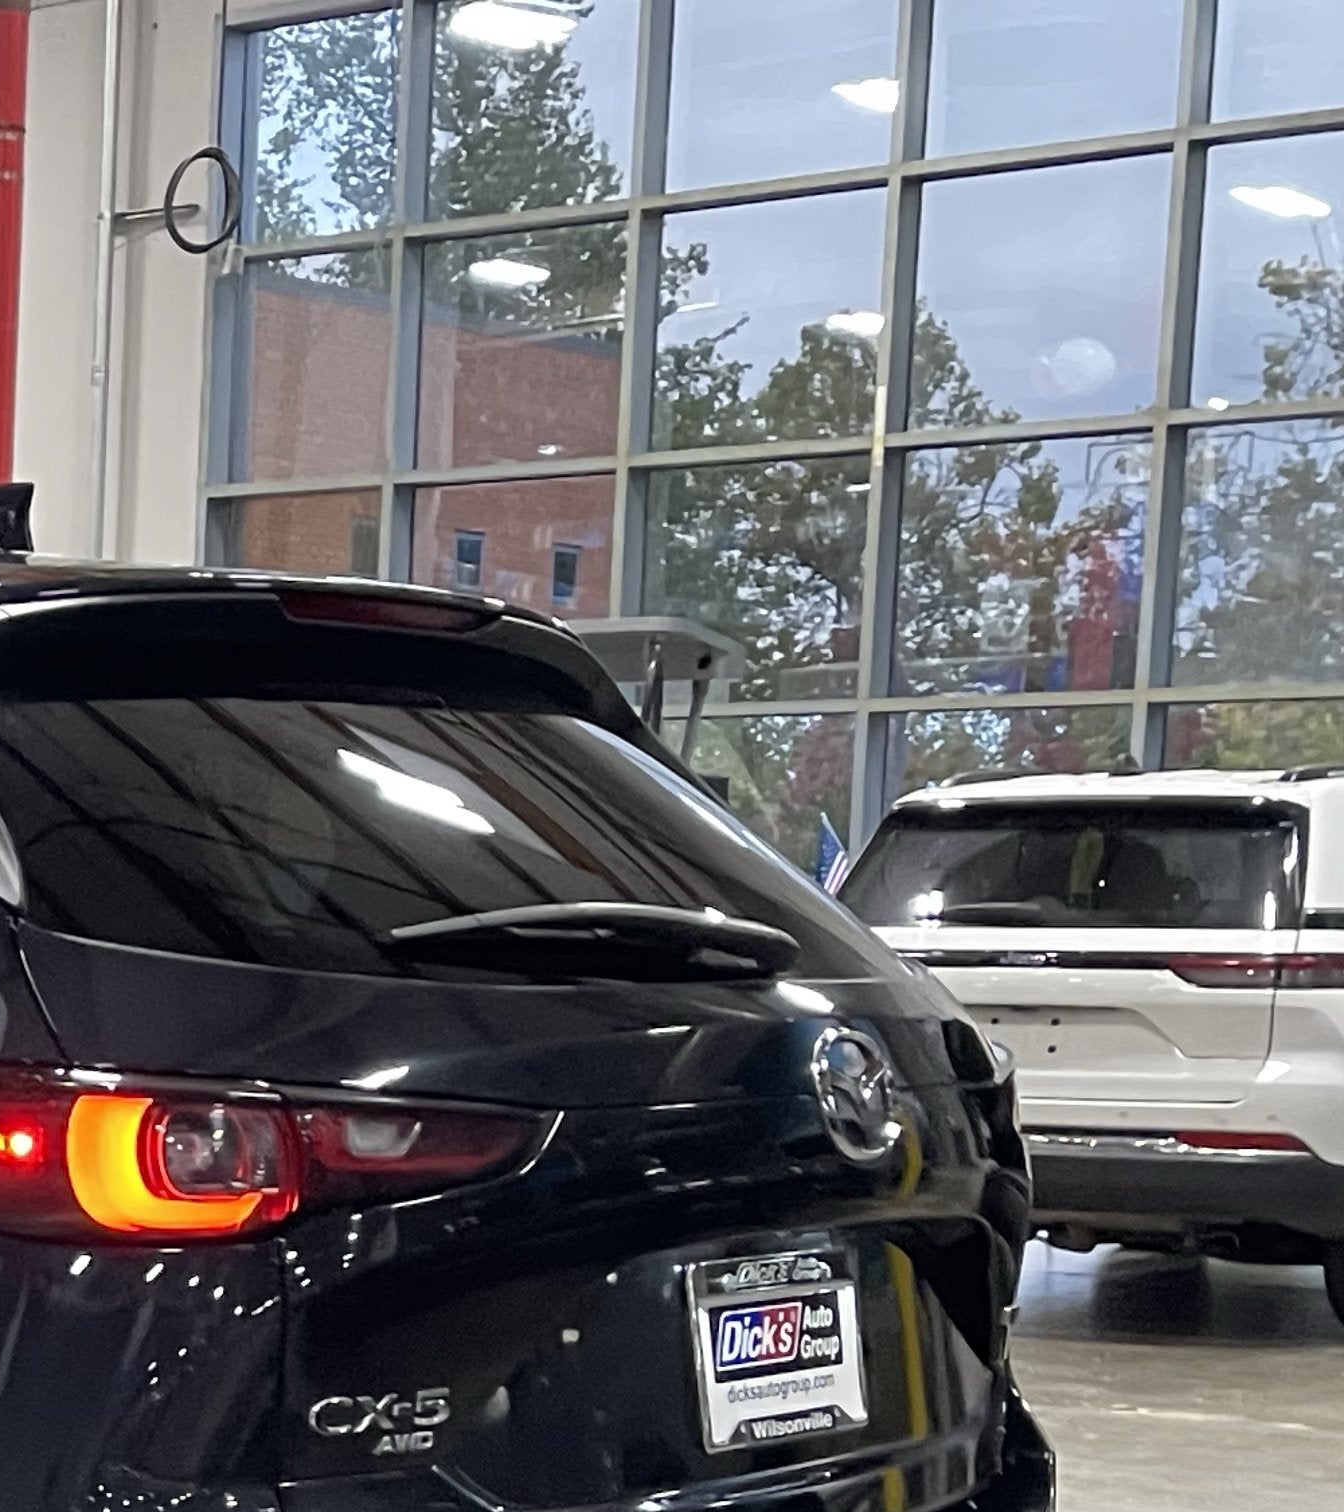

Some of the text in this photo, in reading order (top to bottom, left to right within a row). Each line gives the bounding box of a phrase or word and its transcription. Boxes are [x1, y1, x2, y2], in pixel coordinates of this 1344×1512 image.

[802, 1305, 834, 1330] Auto
[722, 1311, 794, 1363] Dick's
[800, 1335, 841, 1361] Group
[727, 1374, 835, 1404] dicksautogroup.com
[308, 1387, 451, 1437] CX-5
[751, 1412, 834, 1440] Wilsonville
[372, 1431, 434, 1456] AWD
